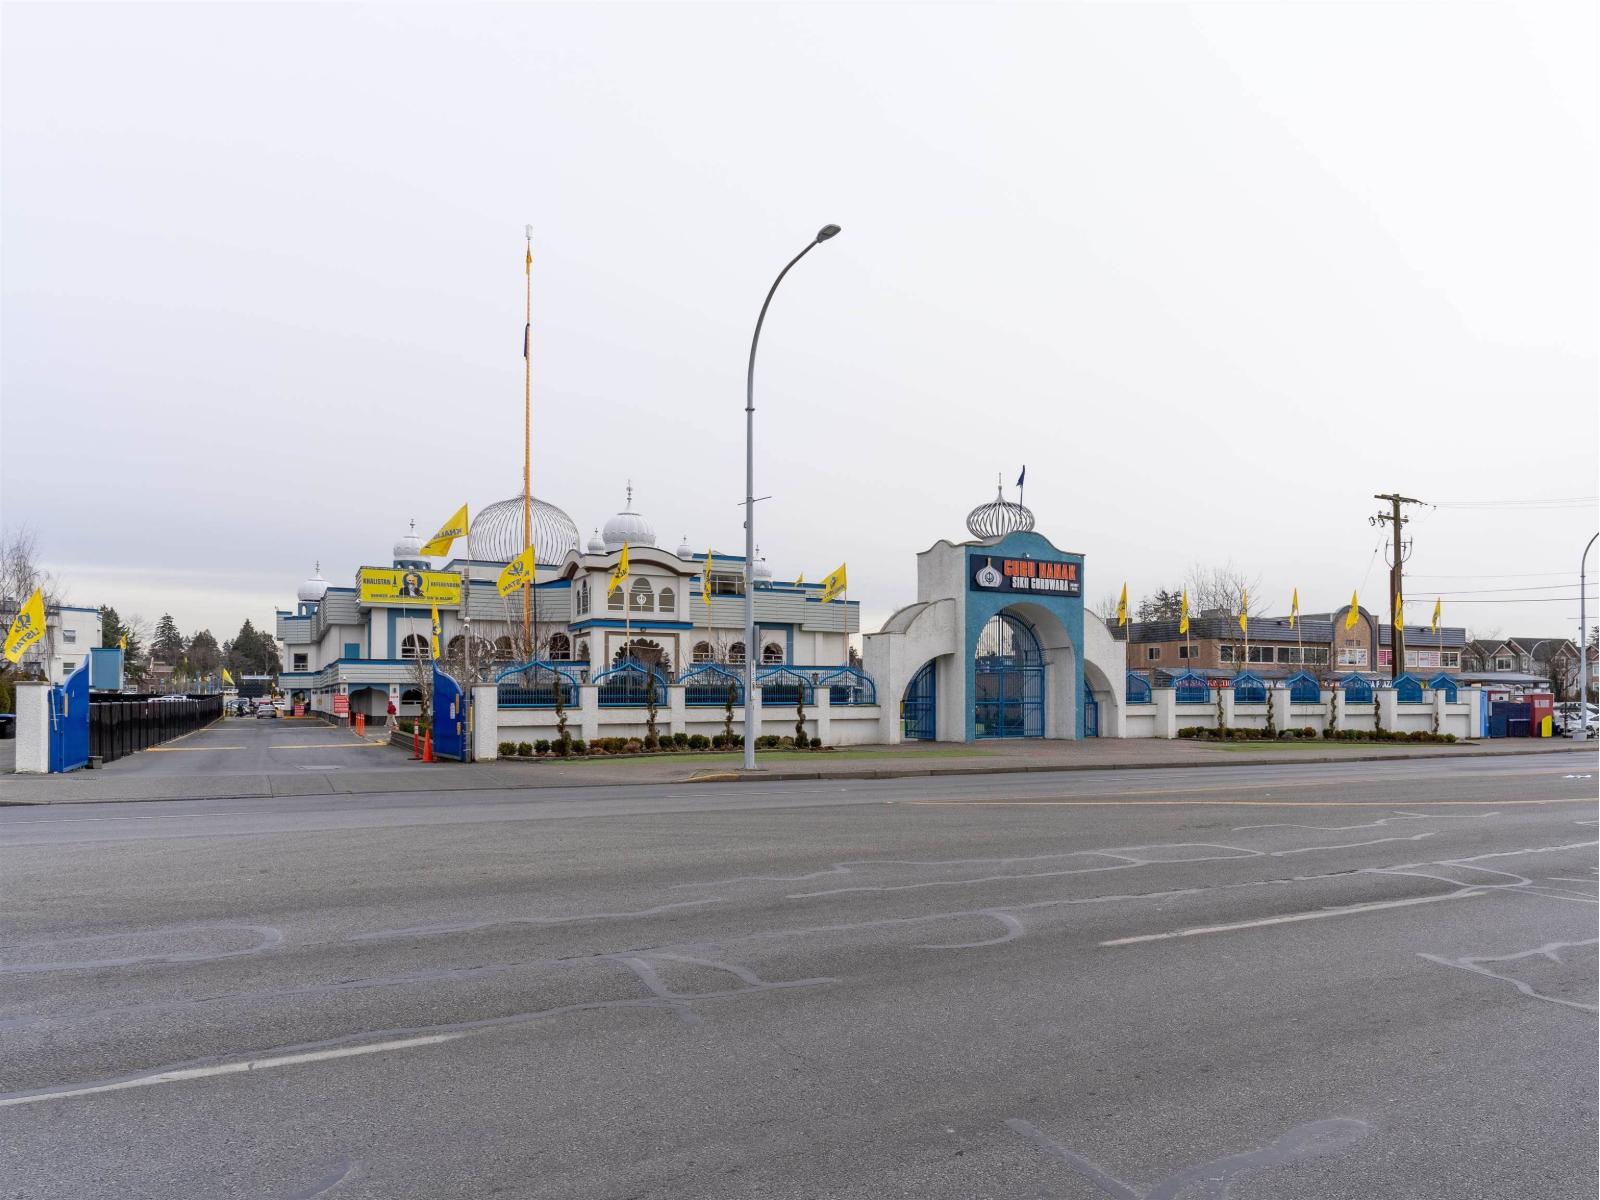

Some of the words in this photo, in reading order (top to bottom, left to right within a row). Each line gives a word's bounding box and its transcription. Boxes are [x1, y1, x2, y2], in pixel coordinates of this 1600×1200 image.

[1003, 559, 1036, 578] GURU
[1038, 562, 1077, 581] NANAK
[1012, 576, 1029, 589] SIKH
[1031, 577, 1069, 592] GURDWARA
